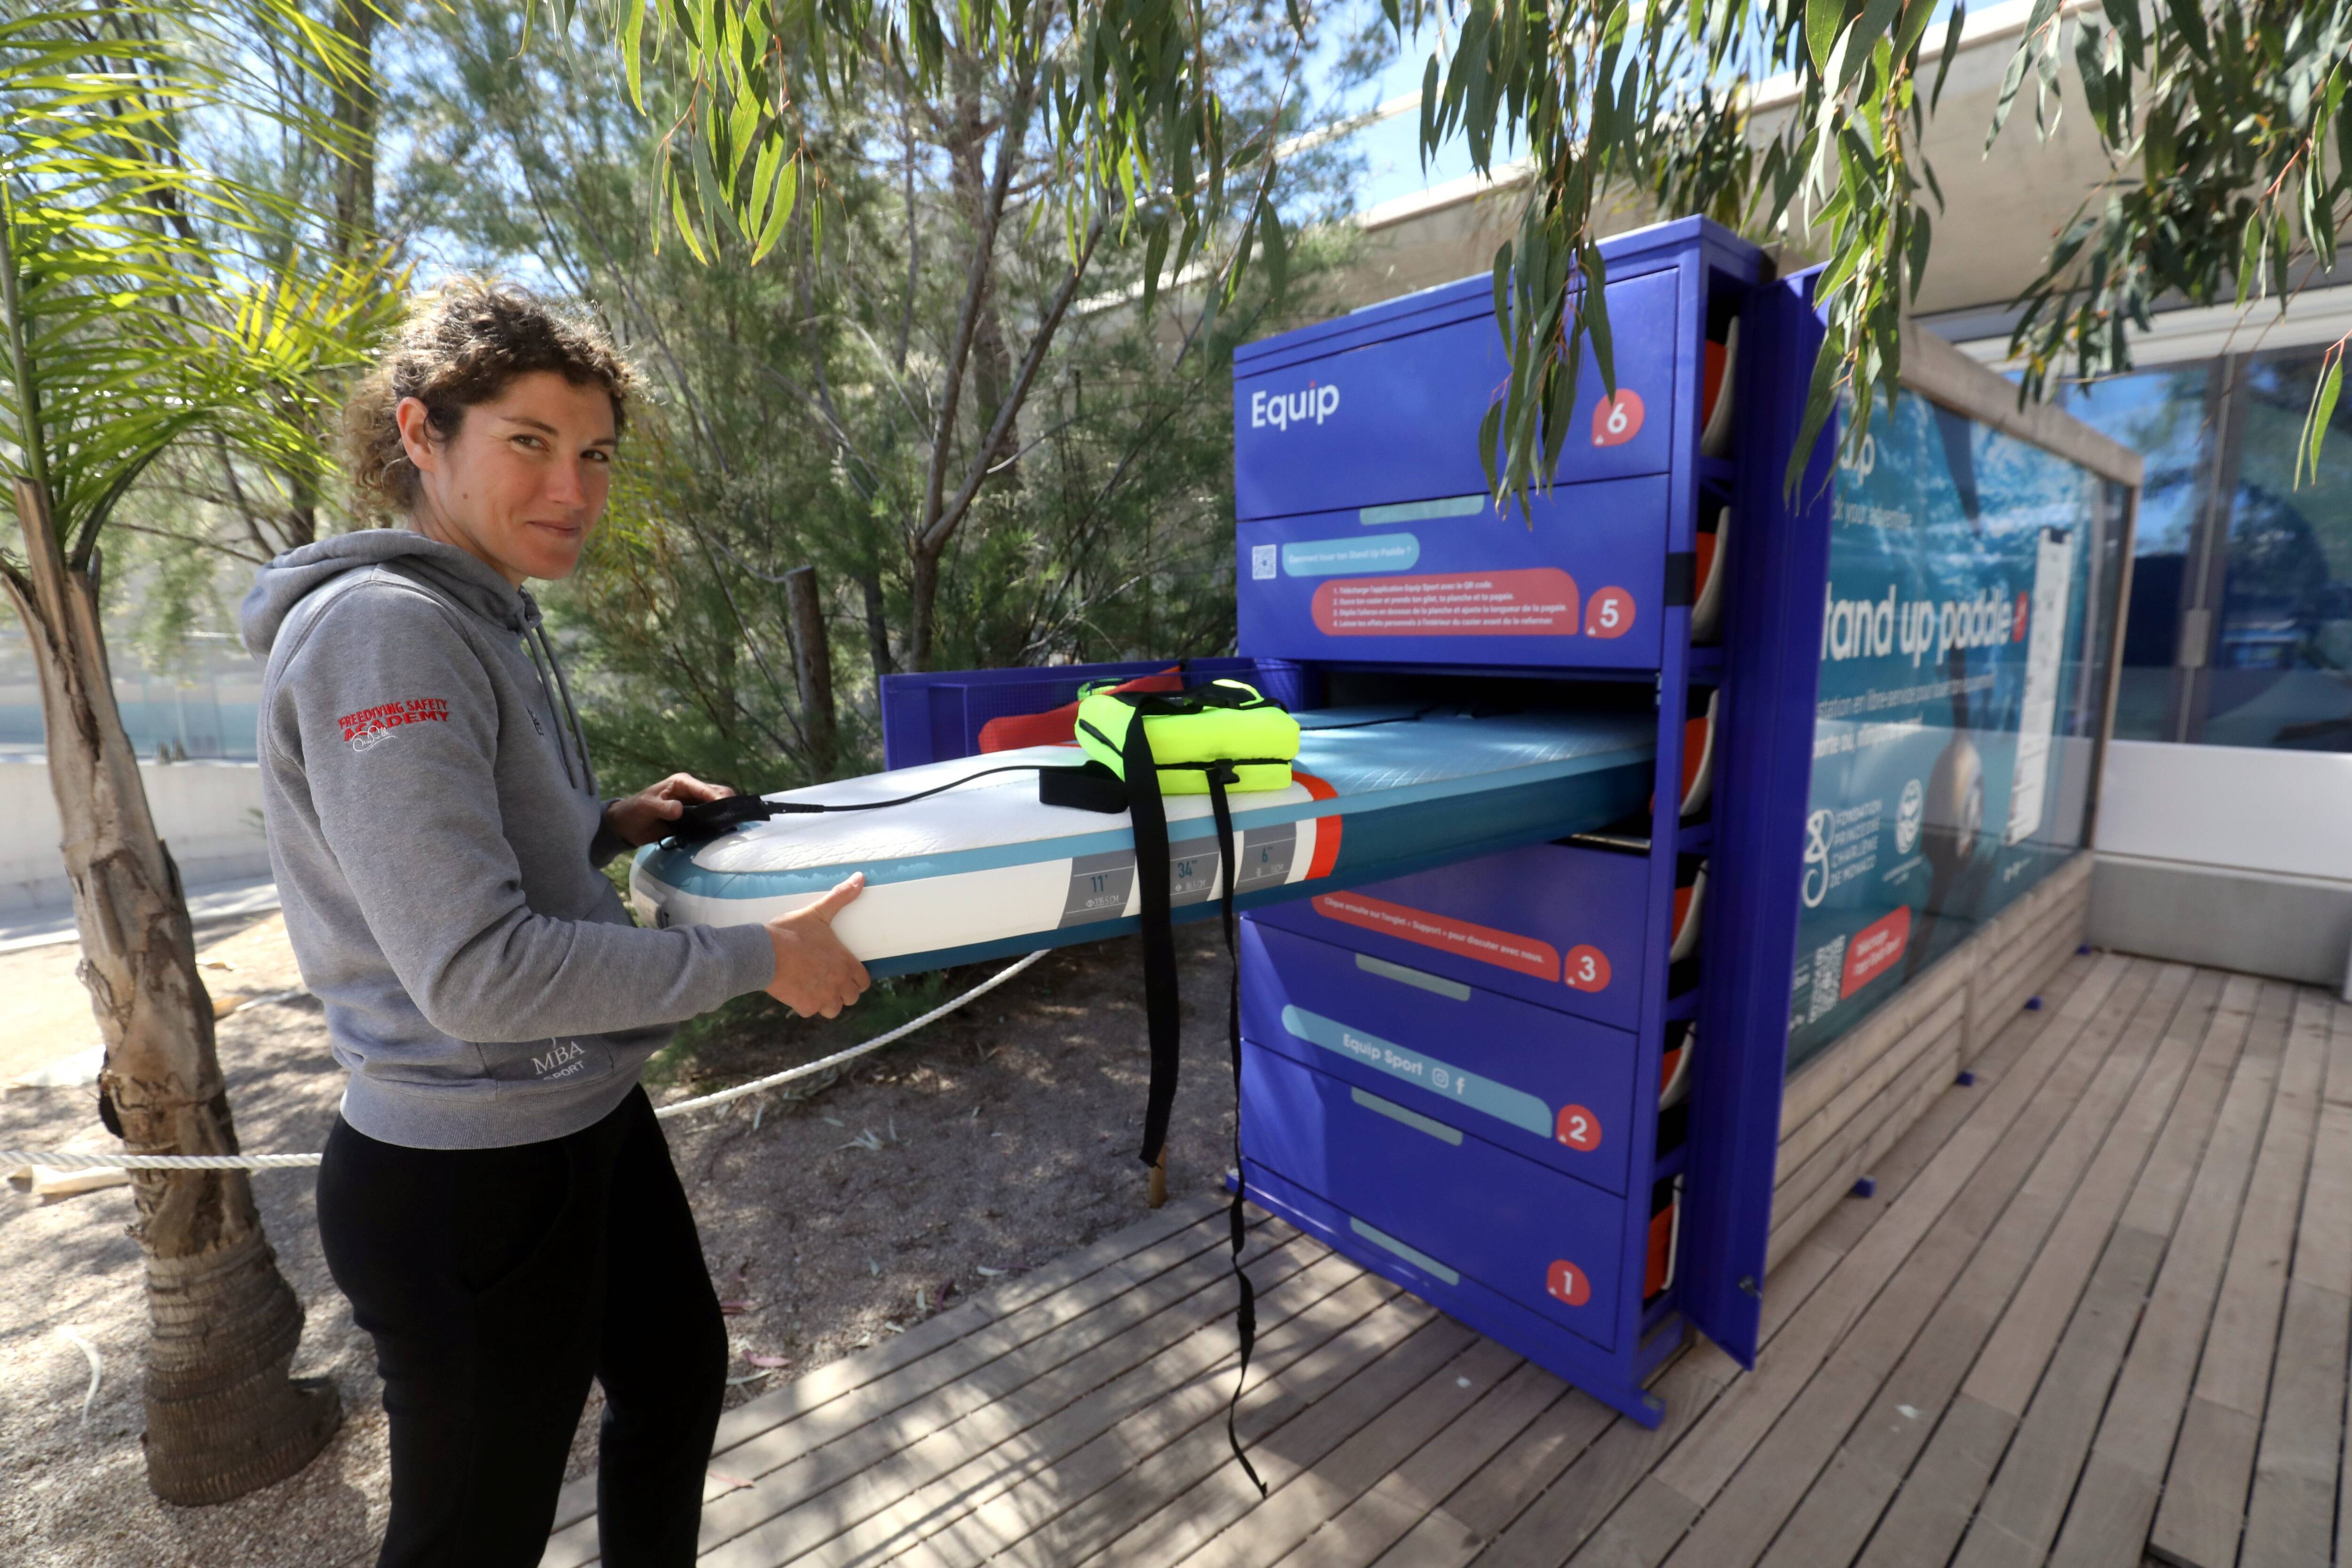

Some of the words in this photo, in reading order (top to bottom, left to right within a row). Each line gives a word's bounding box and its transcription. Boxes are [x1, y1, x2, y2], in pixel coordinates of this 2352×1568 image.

[1252, 380, 1340, 431] Equip
[1607, 402, 1627, 434] 6
[1600, 598, 1619, 628] 5
[1821, 581, 1897, 661] tand
[1900, 599, 1935, 669] up
[1936, 588, 2012, 666] paddle
[338, 701, 405, 730] FREEDIVING
[406, 697, 447, 711] SAFETY
[344, 710, 449, 742] ACADEMY
[1578, 955, 1596, 982] 3
[530, 1041, 586, 1075] MBA
[1343, 1033, 1382, 1061] Equip
[1384, 1049, 1423, 1076] Sport
[1569, 1115, 1588, 1143] 2
[1563, 1270, 1573, 1295] 1
